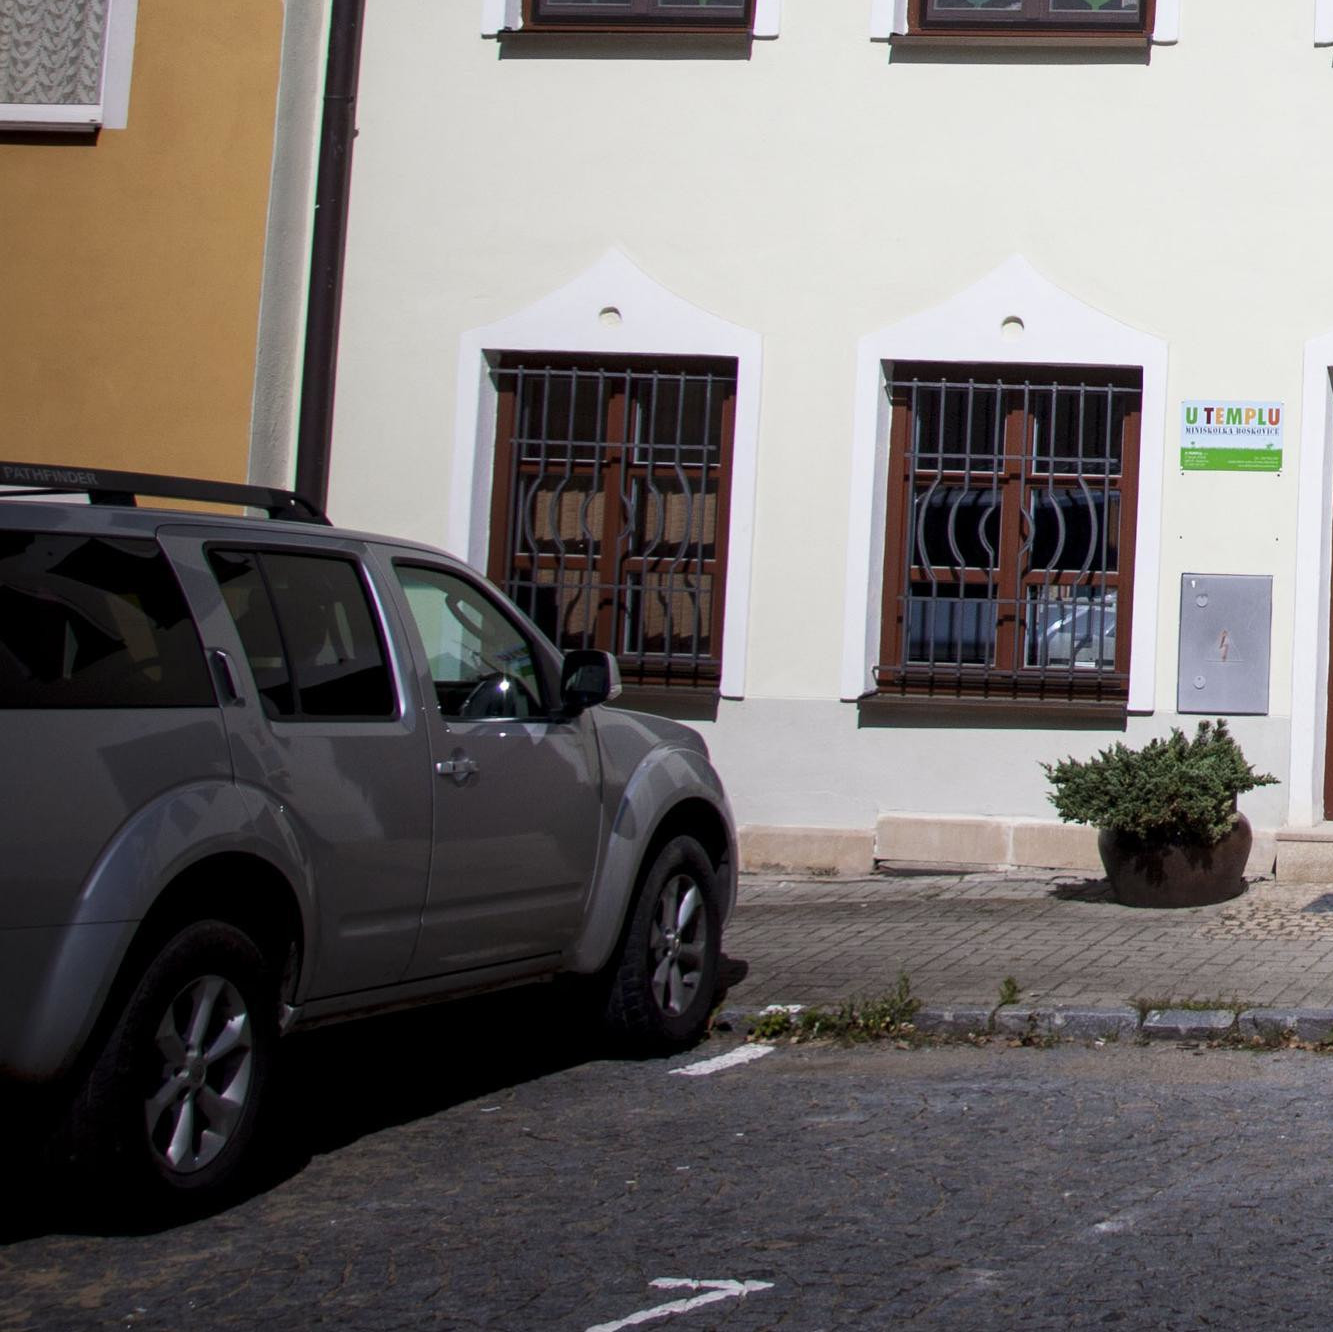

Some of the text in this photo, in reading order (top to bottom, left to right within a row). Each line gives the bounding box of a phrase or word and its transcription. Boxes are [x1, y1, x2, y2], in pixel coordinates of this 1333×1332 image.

[1186, 407, 1280, 425] U TEMPLU
[3, 466, 98, 485] PATHFINDER
